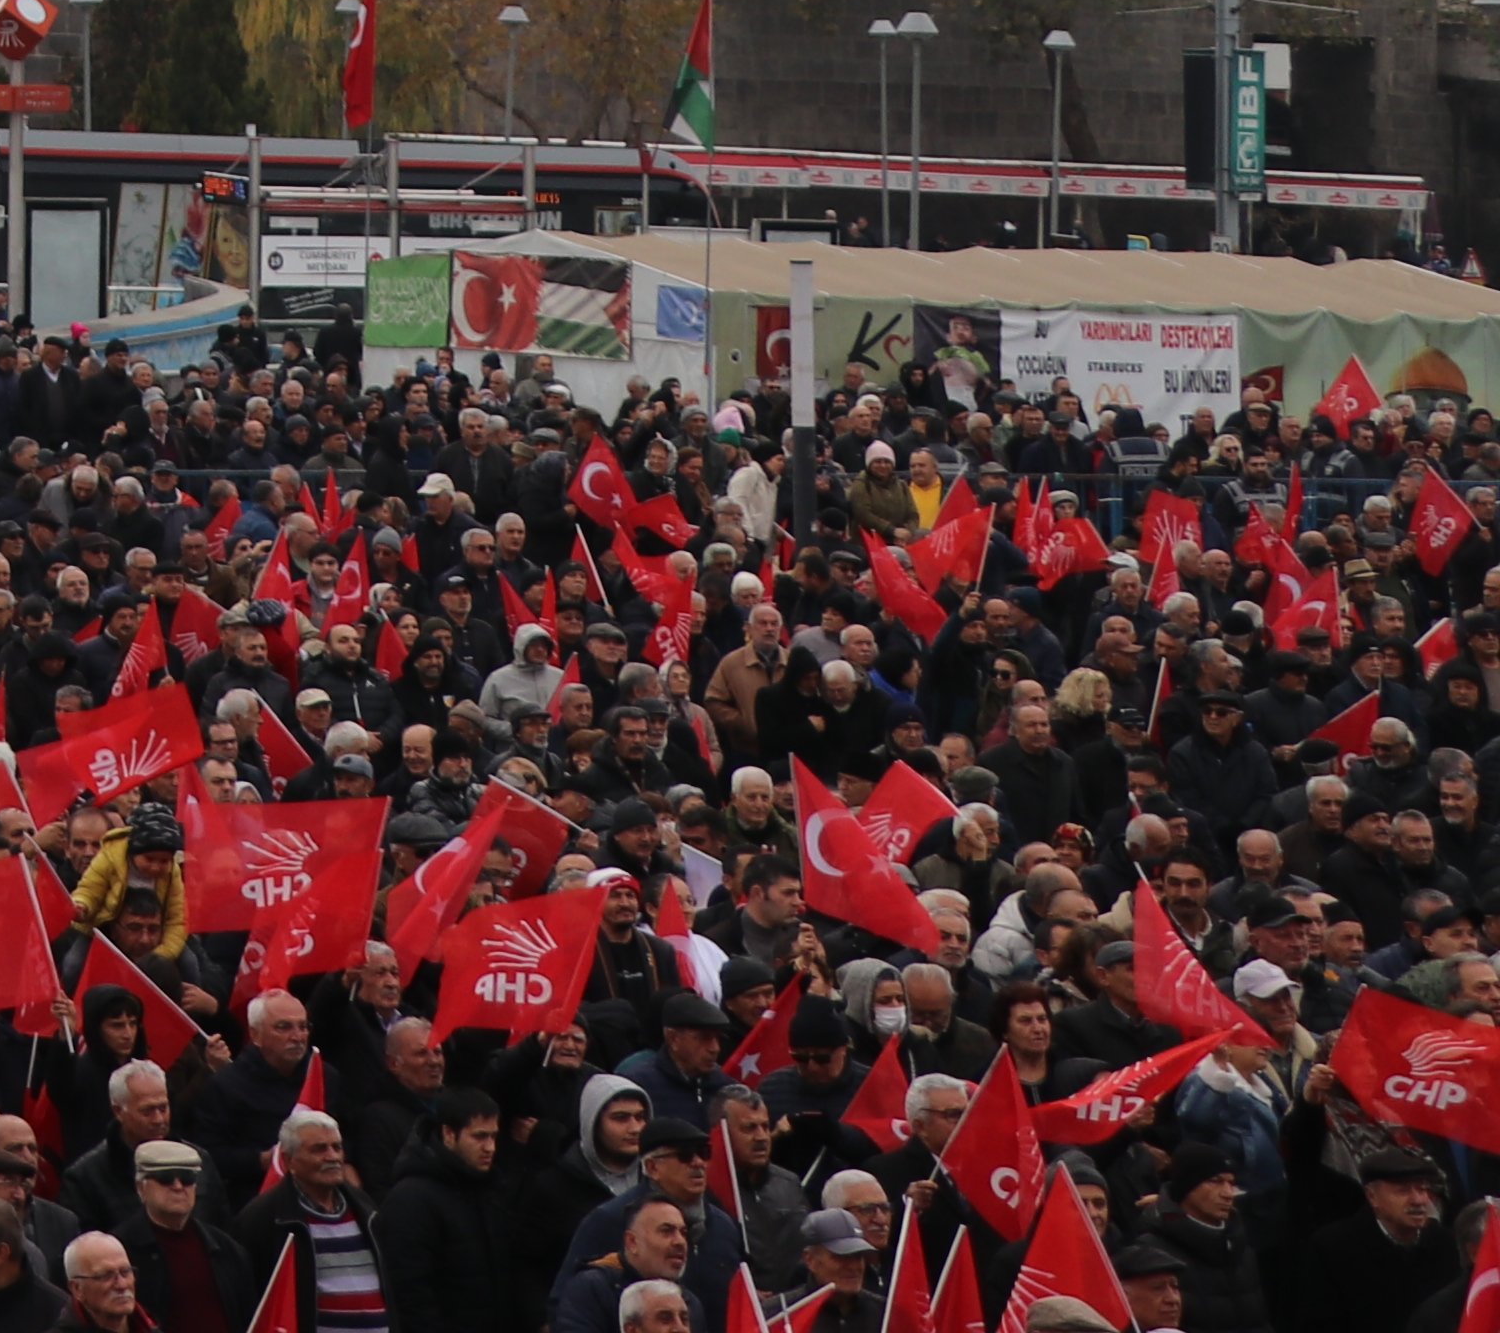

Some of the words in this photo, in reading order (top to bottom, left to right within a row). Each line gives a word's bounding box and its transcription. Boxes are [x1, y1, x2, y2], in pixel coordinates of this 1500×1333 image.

[1080, 321, 1153, 341] YARDIMCILARI
[1016, 352, 1067, 378] ÇOCUĞUN
[1088, 361, 1143, 374] STARBUCKS
[1383, 1074, 1468, 1111] CHP
